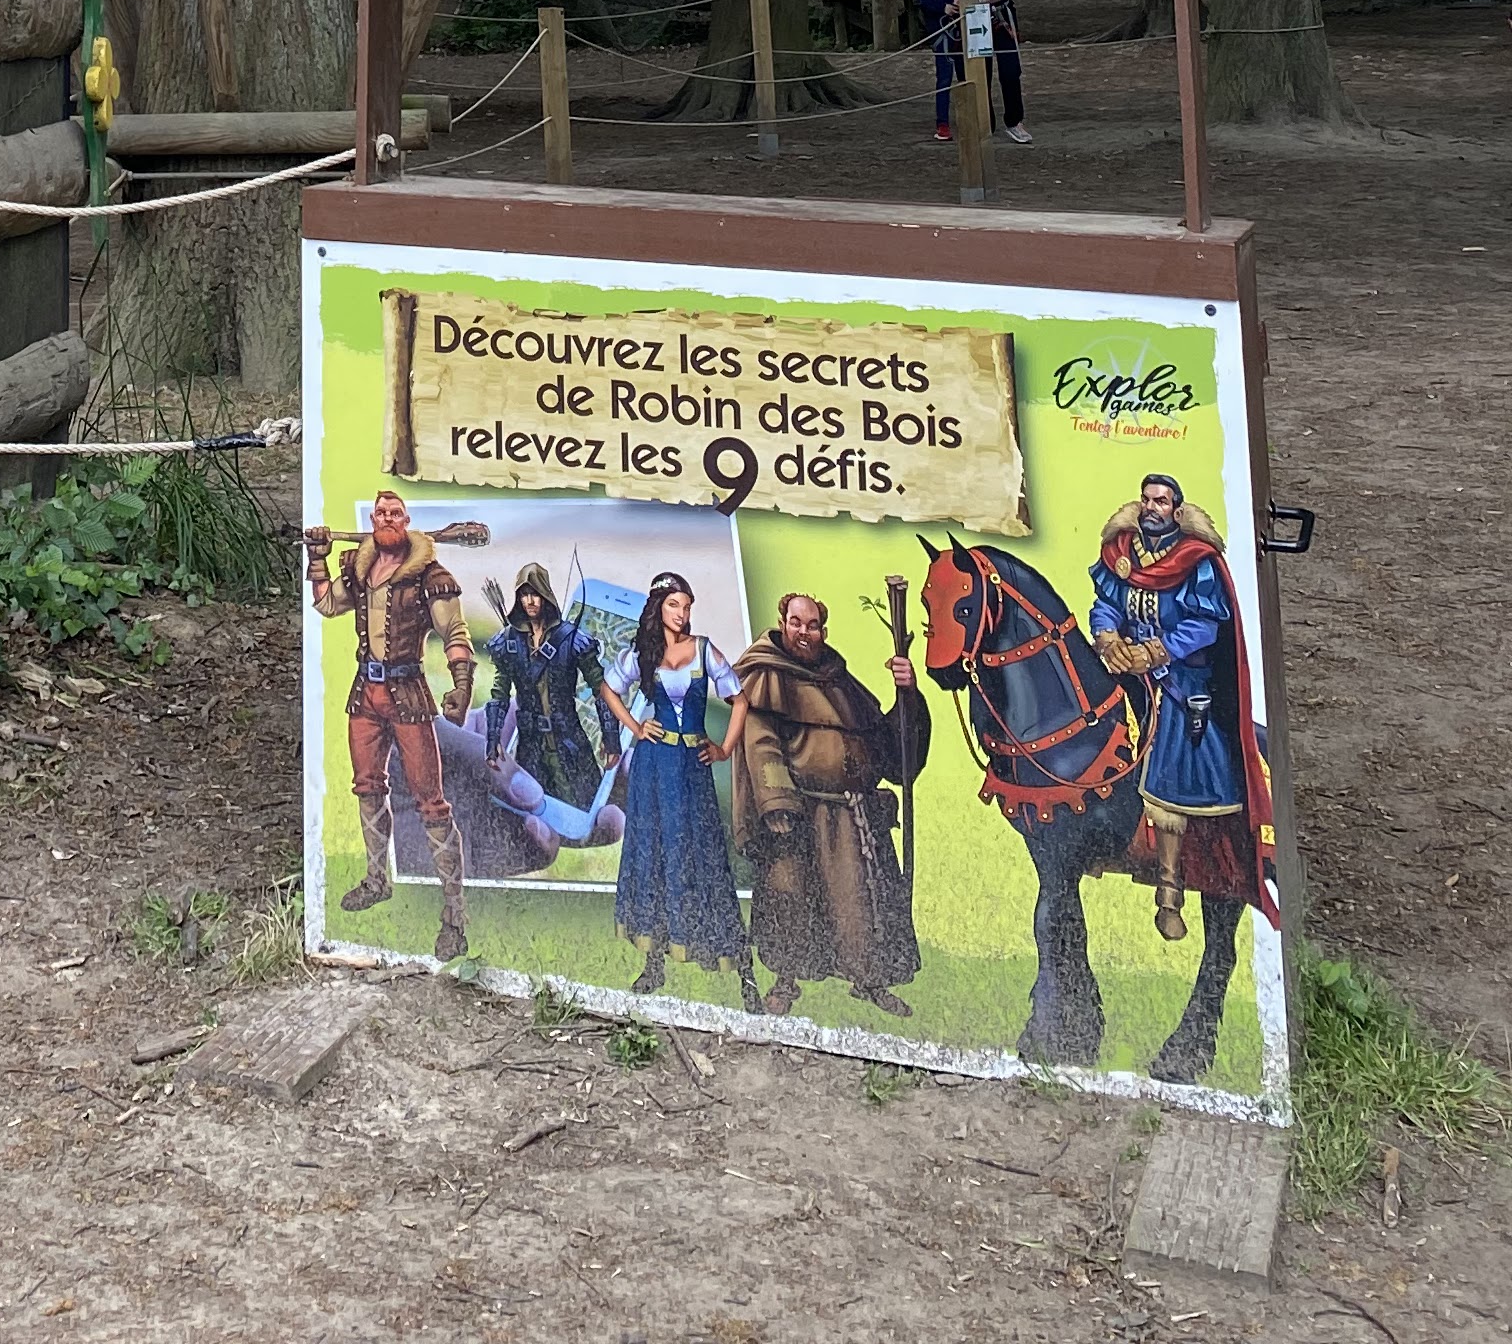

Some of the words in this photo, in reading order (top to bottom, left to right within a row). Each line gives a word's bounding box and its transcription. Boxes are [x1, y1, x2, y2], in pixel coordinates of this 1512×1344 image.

[433, 314, 665, 373] Découvrez
[679, 334, 743, 379] les
[757, 352, 930, 393] secrets
[1052, 357, 1201, 413] Explor
[535, 374, 596, 417] de
[610, 379, 742, 431] Robin
[758, 393, 845, 439] des
[861, 399, 963, 449] Bois
[1109, 398, 1179, 419] games
[451, 420, 606, 471] relevez
[621, 432, 683, 478] les
[702, 436, 760, 517] 9
[773, 444, 907, 496] défis.
